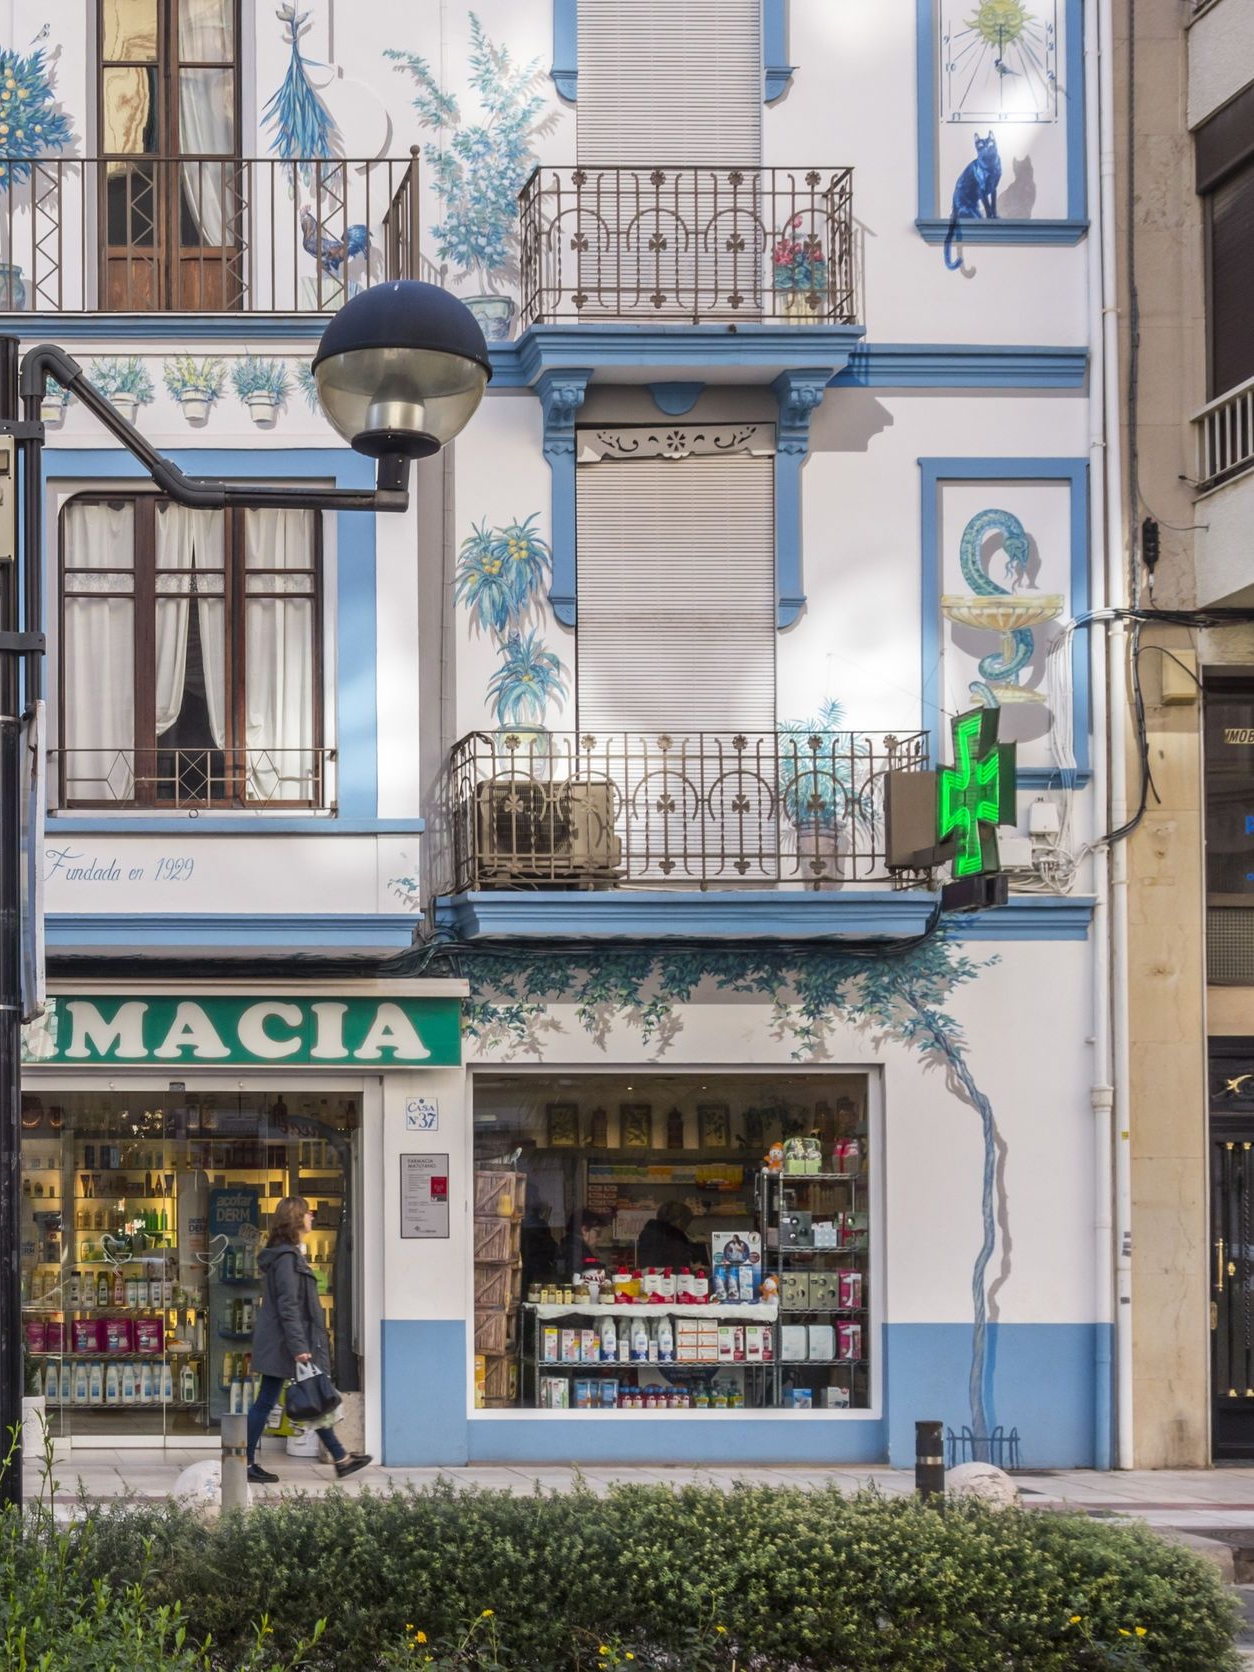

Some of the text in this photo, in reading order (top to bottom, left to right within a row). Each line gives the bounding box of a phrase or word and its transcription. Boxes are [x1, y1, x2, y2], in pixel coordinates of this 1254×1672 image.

[40, 846, 195, 882] Fundada en 1929
[419, 1112, 436, 1128] 37
[216, 1207, 250, 1222] DERM
